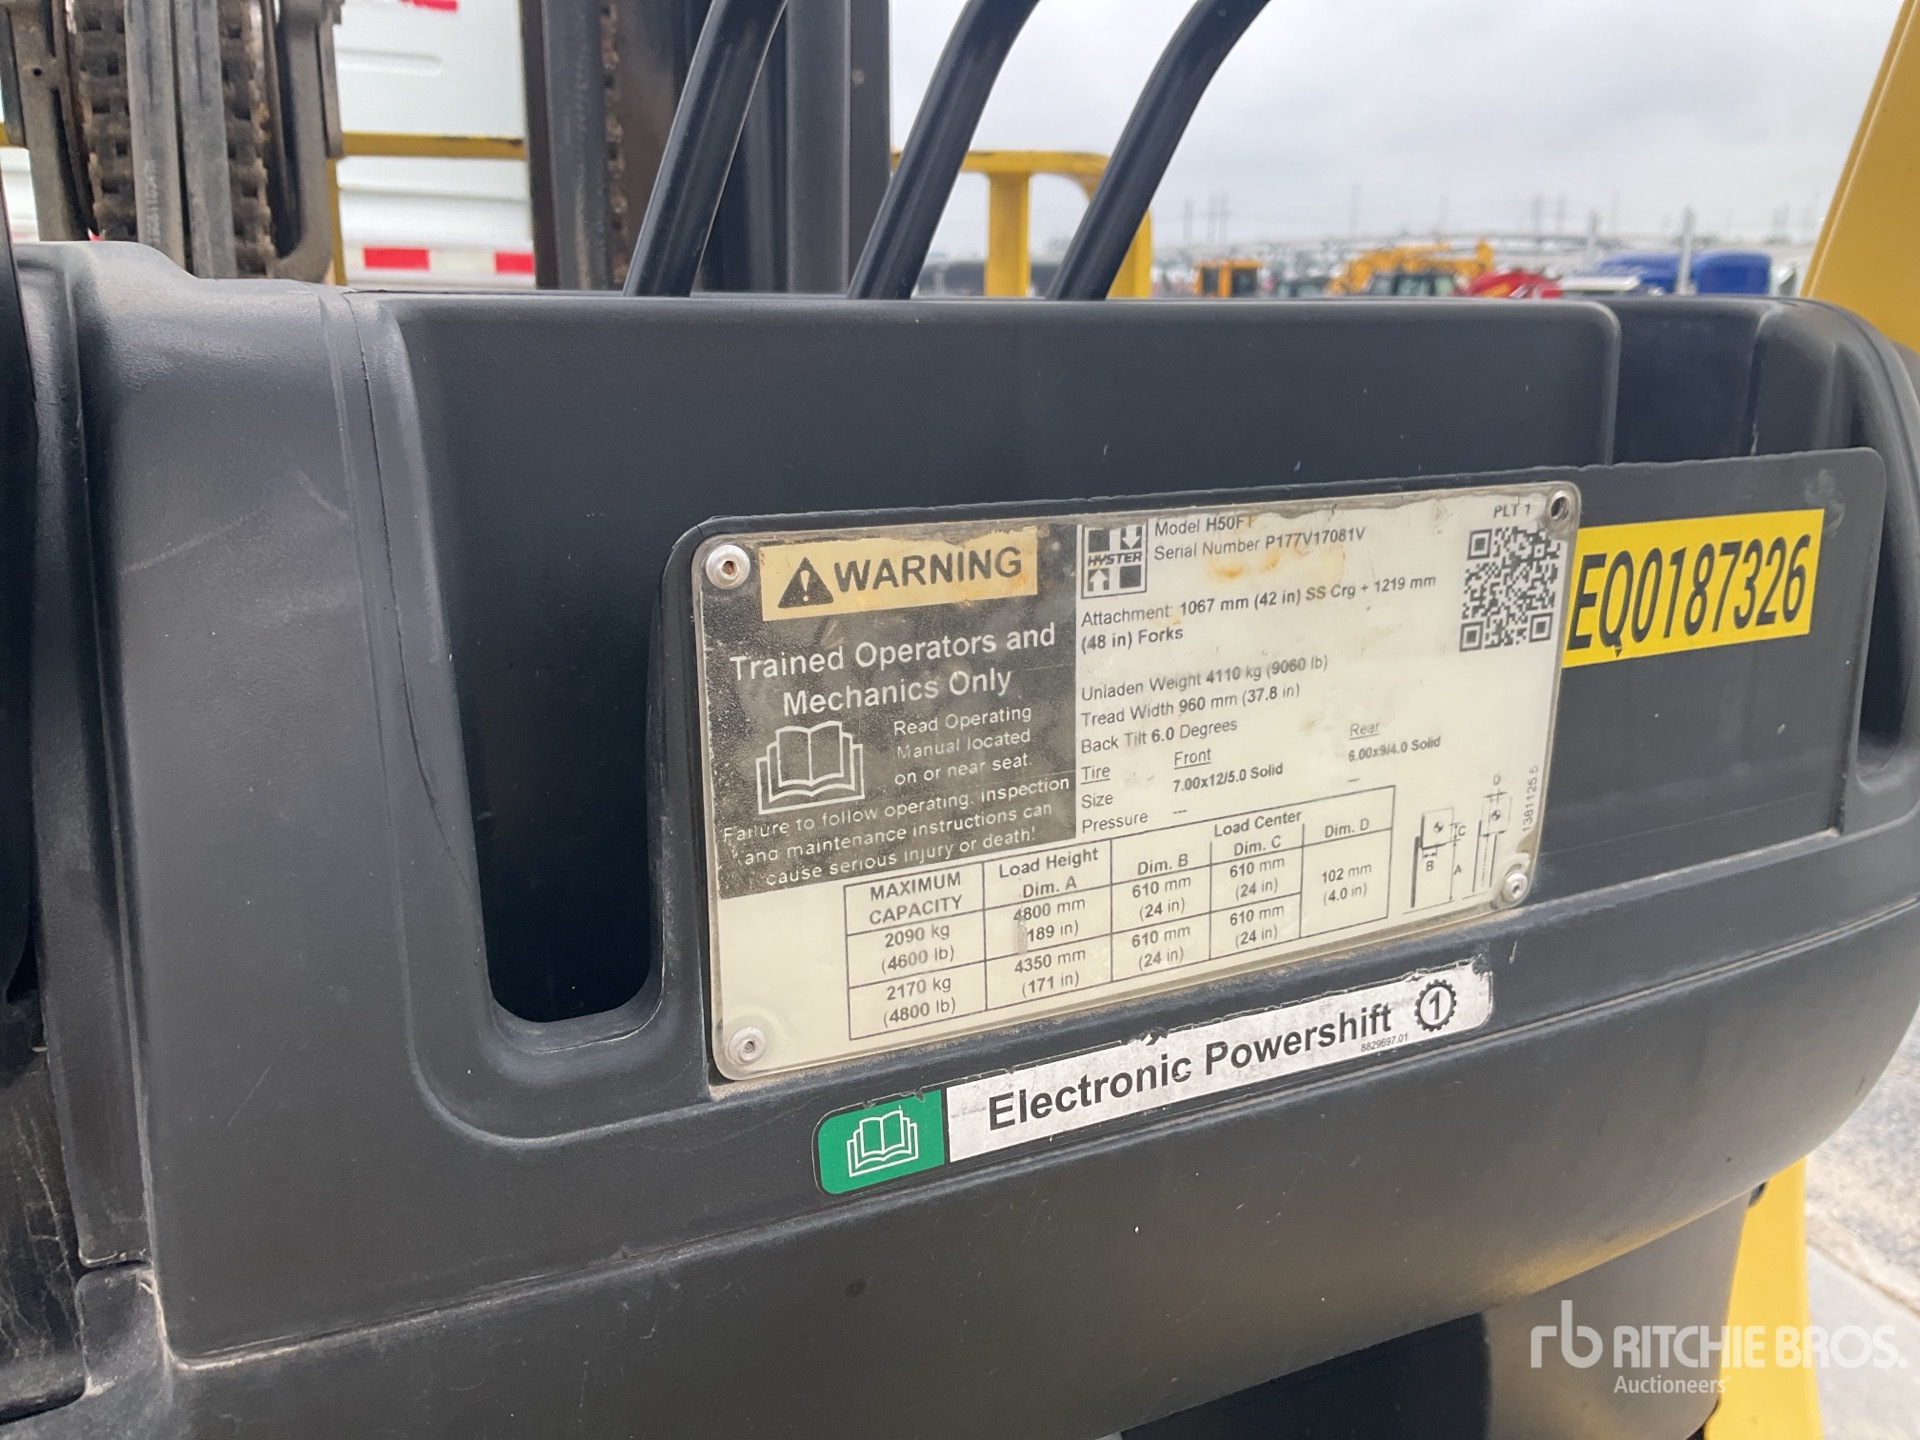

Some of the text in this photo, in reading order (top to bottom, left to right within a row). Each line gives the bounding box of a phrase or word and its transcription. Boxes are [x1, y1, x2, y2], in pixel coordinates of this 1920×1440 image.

[1493, 503, 1518, 519] PLT
[1154, 518, 1200, 537] Model
[1154, 526, 1366, 561] Serial Number P177V17081V
[833, 546, 1022, 593] WARNING
[1087, 551, 1142, 567] HYSTER
[1180, 598, 1215, 616] 1067
[1220, 596, 1249, 611] mm
[1254, 590, 1277, 611] (42
[1282, 588, 1301, 604] in)
[1306, 587, 1326, 600] SS
[1331, 584, 1356, 599] Crg
[1374, 577, 1405, 594] 1219
[1410, 576, 1437, 589] mm
[1566, 533, 1812, 658] EQ0187326
[730, 622, 1056, 681] Trained Operators and
[1081, 626, 1183, 655] (48 in) Forks
[1081, 655, 1328, 701] Unladen Weight 4110 kg (9060 lb)
[783, 667, 1012, 717] Mechanics Only
[1081, 682, 1300, 728] Tread Width 960 mm (37.8 in)
[894, 706, 1031, 736] Read Operating
[897, 728, 1031, 759] Manual located
[1081, 719, 1238, 754] Back Tilt 6.0 Degrees
[1081, 722, 1380, 781] Tire Front Rear
[894, 772, 917, 785] on
[924, 769, 941, 781] or
[948, 761, 985, 777] near
[1081, 793, 1114, 809] Size
[1173, 769, 1247, 792] 7.00x12/5.0
[1250, 763, 1284, 779] Solid
[1411, 737, 1441, 751] Solid
[723, 822, 790, 842] Failure
[796, 818, 815, 831] to
[822, 808, 878, 826] follow
[981, 776, 1070, 802] inspection
[745, 803, 1052, 865] and maintenance instructions can
[1082, 812, 1148, 832] Pressure
[1214, 811, 1302, 838] Load Center
[1324, 818, 1370, 838] Dim. D
[767, 826, 1035, 886] cause serious injury or death!
[1233, 835, 1282, 856] Dim. C
[999, 848, 1099, 879] Load Height
[1137, 853, 1189, 876] Dim. B
[1229, 857, 1285, 879] 610 mm
[1321, 863, 1372, 884] 102 mm
[1426, 860, 1434, 871] B
[1453, 864, 1462, 875] A
[870, 871, 961, 901] MAXIMUM
[1023, 876, 1077, 898] Dim. A
[1132, 876, 1191, 898] 610 mm
[1235, 878, 1279, 900] (24 in)
[1323, 882, 1367, 906] (4.0 in)
[869, 895, 962, 925] CAPACITY
[1013, 899, 1086, 921] 4800 mm
[1139, 897, 1185, 921] (24 in)
[1229, 904, 1285, 926] 610 mm
[884, 924, 950, 949] 2090 kg
[1027, 920, 1079, 943] 189 in)
[1131, 925, 1190, 948] 610 mm
[1235, 924, 1279, 949] (24 in)
[881, 945, 955, 975] (4600 lb)
[1014, 949, 1086, 974] 4350 mm
[1138, 946, 1184, 971] (24 in)
[886, 977, 952, 1001] 2170 kg
[1022, 971, 1080, 998] (171 in)
[883, 997, 956, 1028] (4800 lb)
[1361, 1033, 1408, 1052] 8829697.01
[988, 1052, 1192, 1131] Electronic
[1206, 1002, 1391, 1075] Powershift
